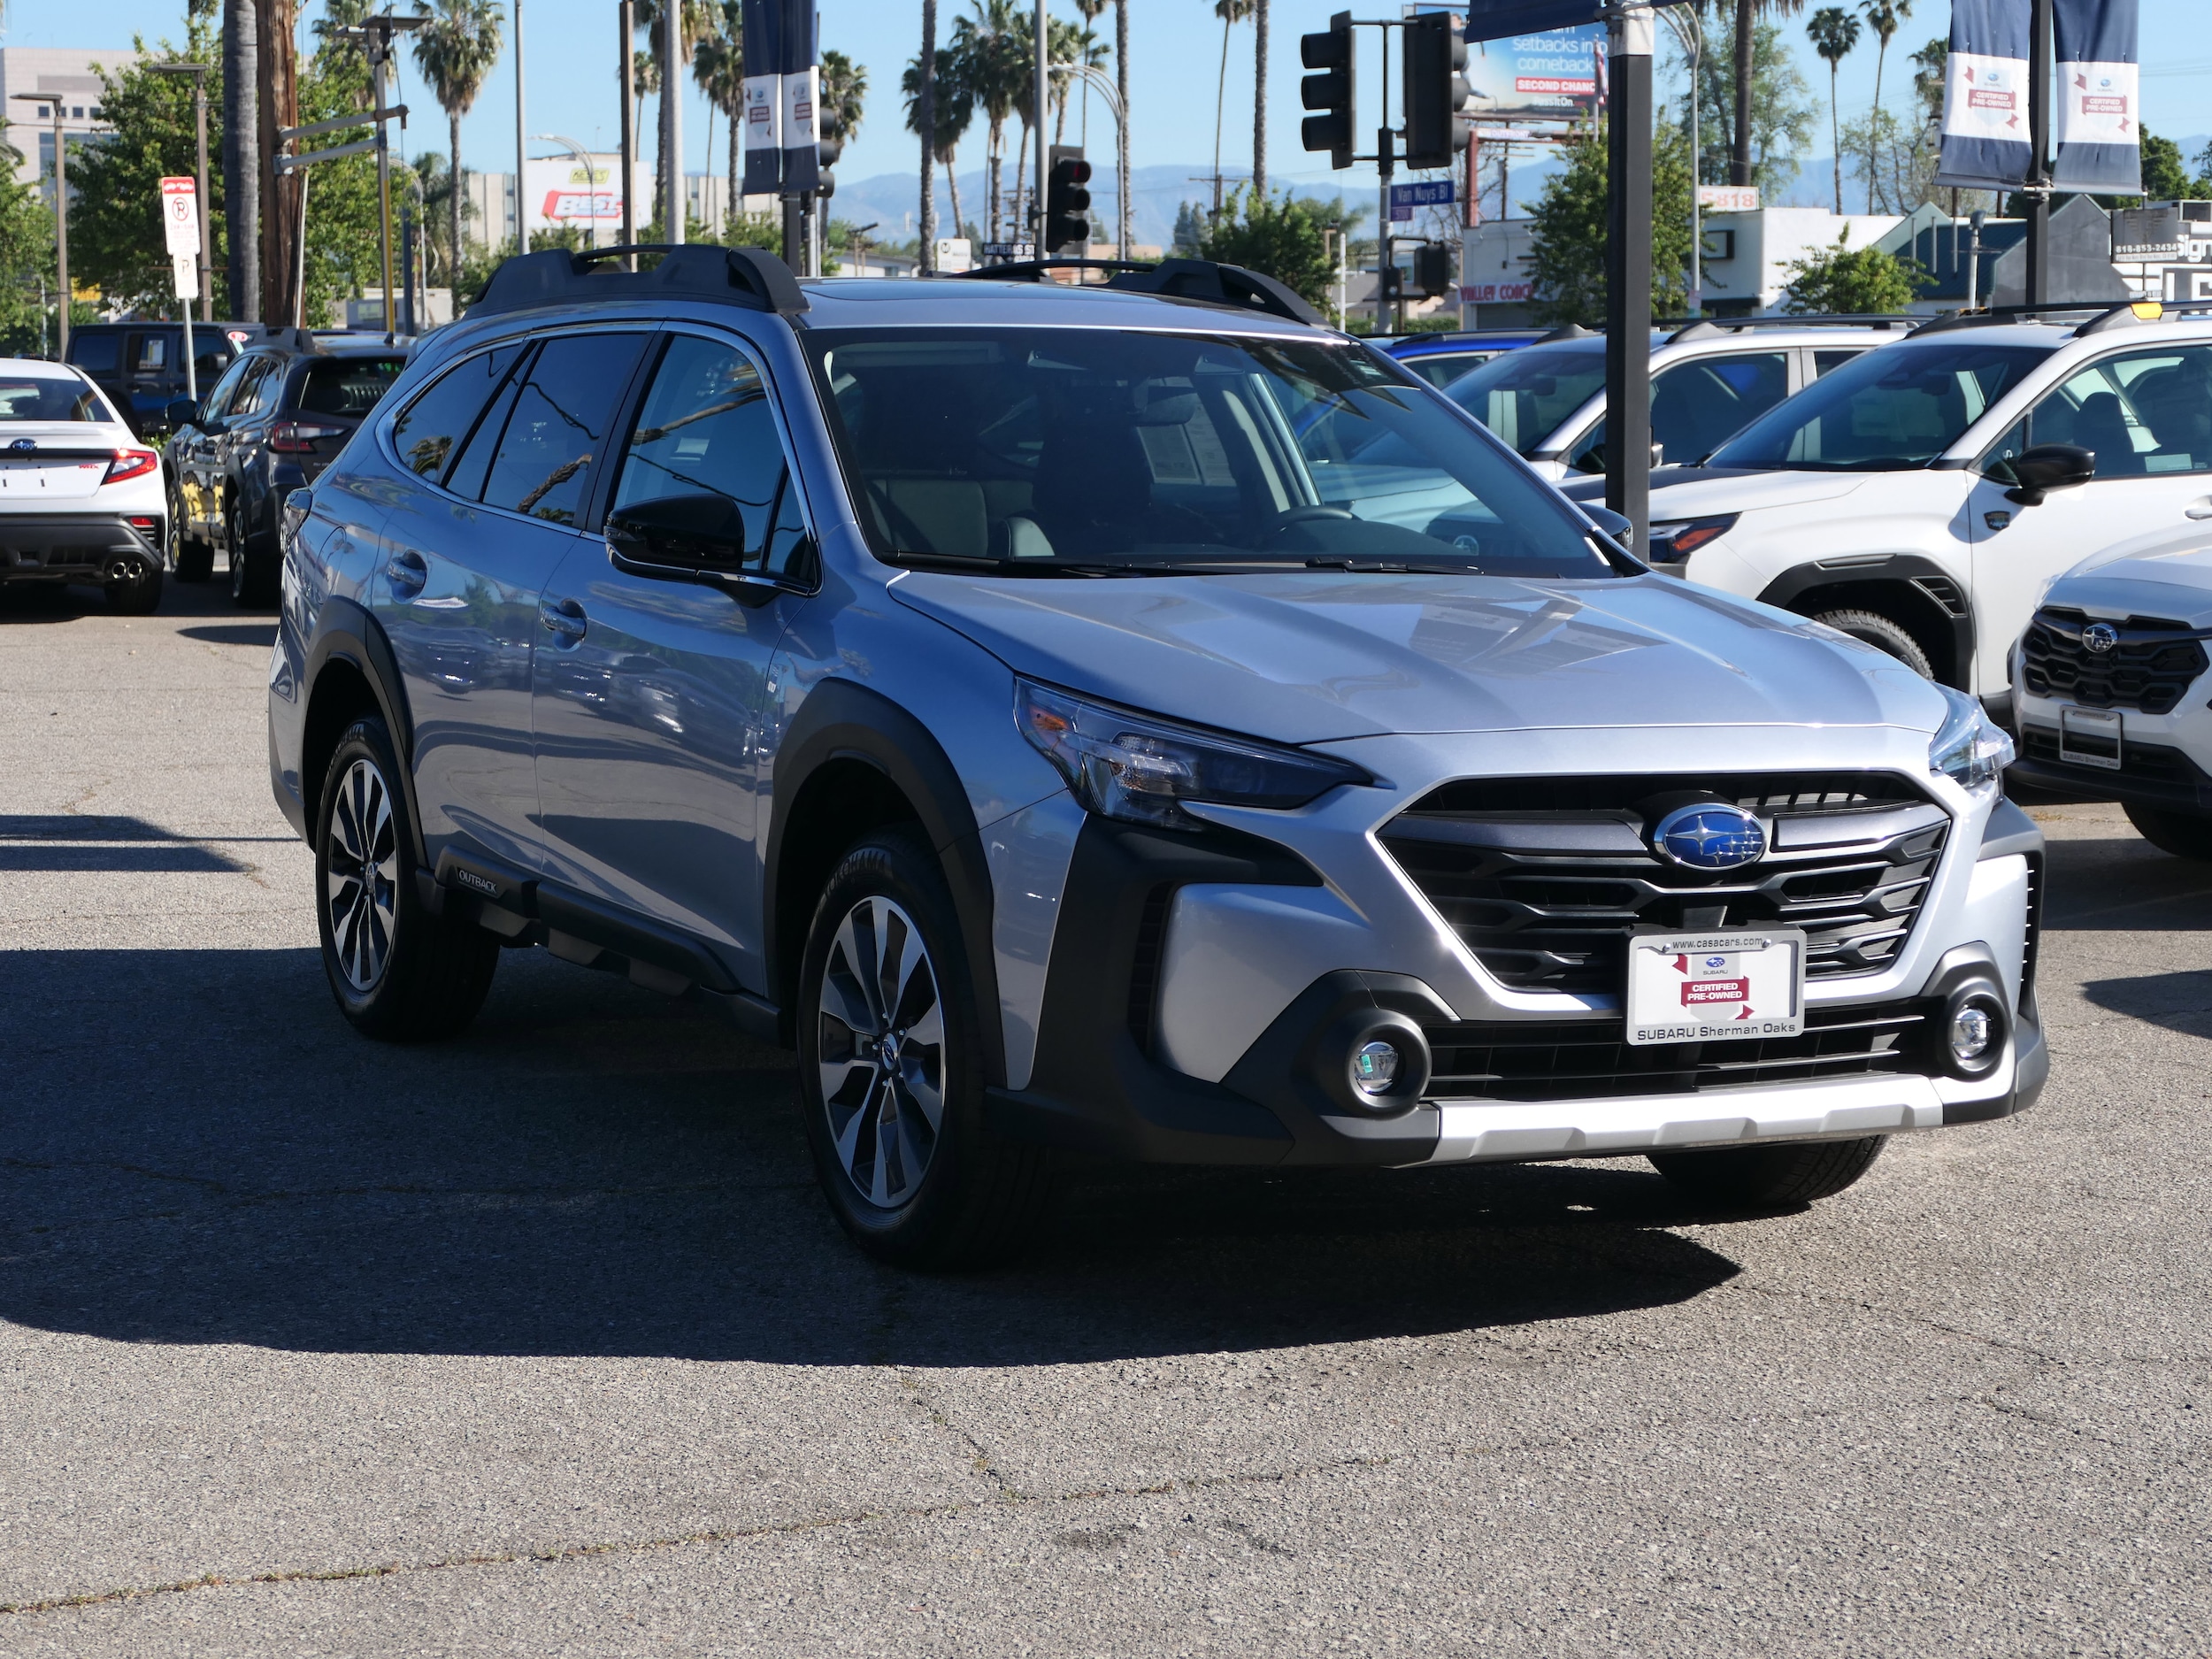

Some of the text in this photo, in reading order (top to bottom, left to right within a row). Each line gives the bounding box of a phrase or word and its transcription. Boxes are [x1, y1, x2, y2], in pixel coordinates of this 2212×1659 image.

[1513, 37, 1609, 54] setbacks ino
[1517, 80, 1596, 92] SECOND CHANC
[1971, 97, 2012, 108] PRE-OWNED
[1976, 91, 2009, 102] CERTIFIED
[1397, 183, 1448, 205] Van Nuys Bl
[458, 869, 497, 895] OUTBACK
[1672, 937, 1763, 949] www.casacars.com
[1692, 982, 1739, 993] CERTIFIED
[1687, 991, 1743, 1002] PRE-OWNED
[1638, 1023, 1795, 1041] SUBARU Sherman Oaks
